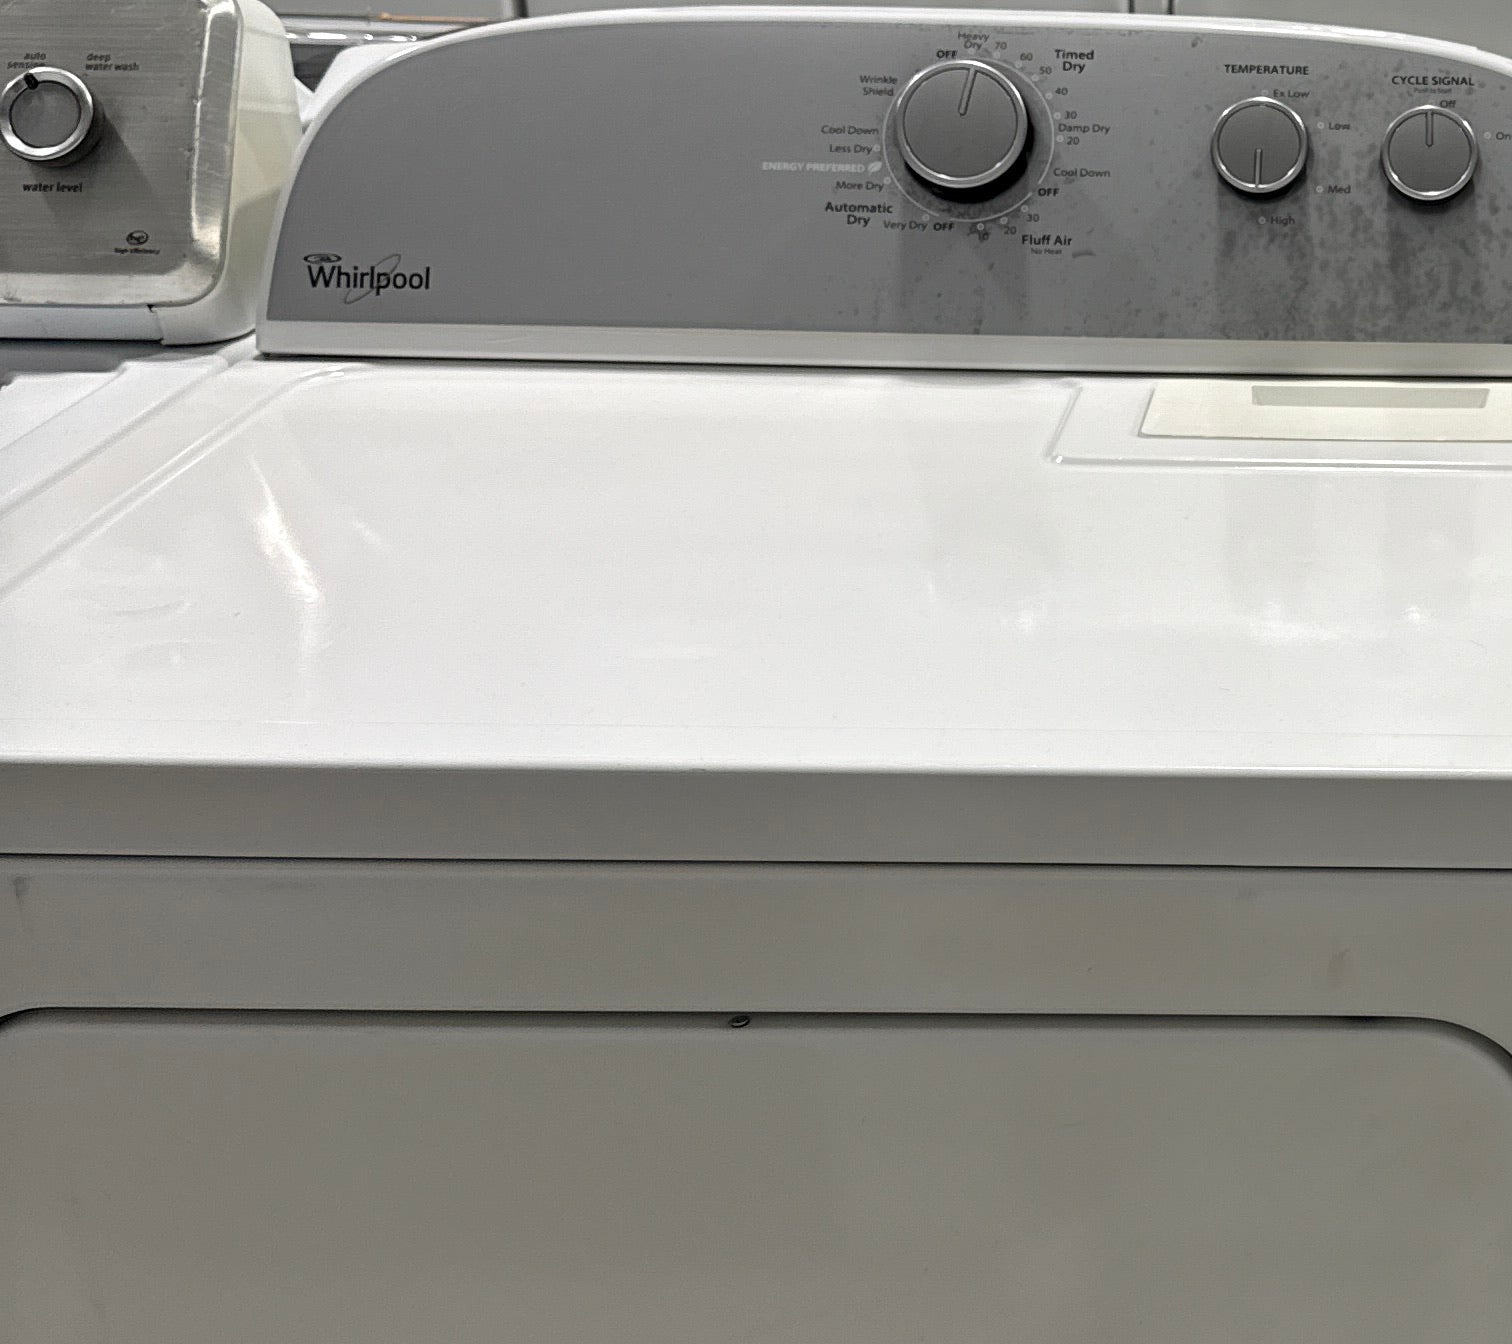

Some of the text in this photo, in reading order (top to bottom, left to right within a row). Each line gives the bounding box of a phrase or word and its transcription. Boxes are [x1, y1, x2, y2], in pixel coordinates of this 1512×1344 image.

[957, 31, 990, 43] Heavy
[963, 38, 983, 51] Dry
[995, 42, 1008, 50] 70
[86, 53, 111, 62] deep
[936, 49, 958, 59] OFF
[1055, 48, 1095, 61] Timed
[85, 62, 139, 71] water wash
[1039, 66, 1052, 75] 50
[1062, 61, 1086, 74] Dry
[1225, 64, 1310, 75] TEMPERATURE
[859, 74, 898, 85] Wrinkle
[1391, 76, 1475, 87] CYCLE SIGNAL
[862, 85, 894, 97] Shield
[1055, 87, 1068, 96] 40
[1273, 89, 1310, 98] Ex Low
[1439, 99, 1457, 108] Off
[821, 125, 879, 136] Cool Down
[1058, 123, 1111, 135] Damp Dry
[1329, 122, 1351, 131] Low
[1066, 136, 1080, 146] 20
[1495, 131, 1512, 141] On
[829, 144, 873, 155] Less Dry
[762, 161, 802, 172] ENERGY
[1053, 168, 1111, 178] Cool Down
[22, 181, 83, 193] water level
[835, 181, 884, 193] More Dry
[1037, 187, 1060, 197] OFF
[1328, 184, 1351, 194] Med
[825, 201, 894, 214] Automatic
[846, 214, 871, 228] Dry
[1026, 213, 1040, 223] 30
[1270, 215, 1296, 227] High
[883, 219, 954, 232] Very Dry OFF
[1003, 225, 1017, 236] 20
[1021, 233, 1073, 247] Fluff Air
[307, 263, 431, 297] Whirlpool
